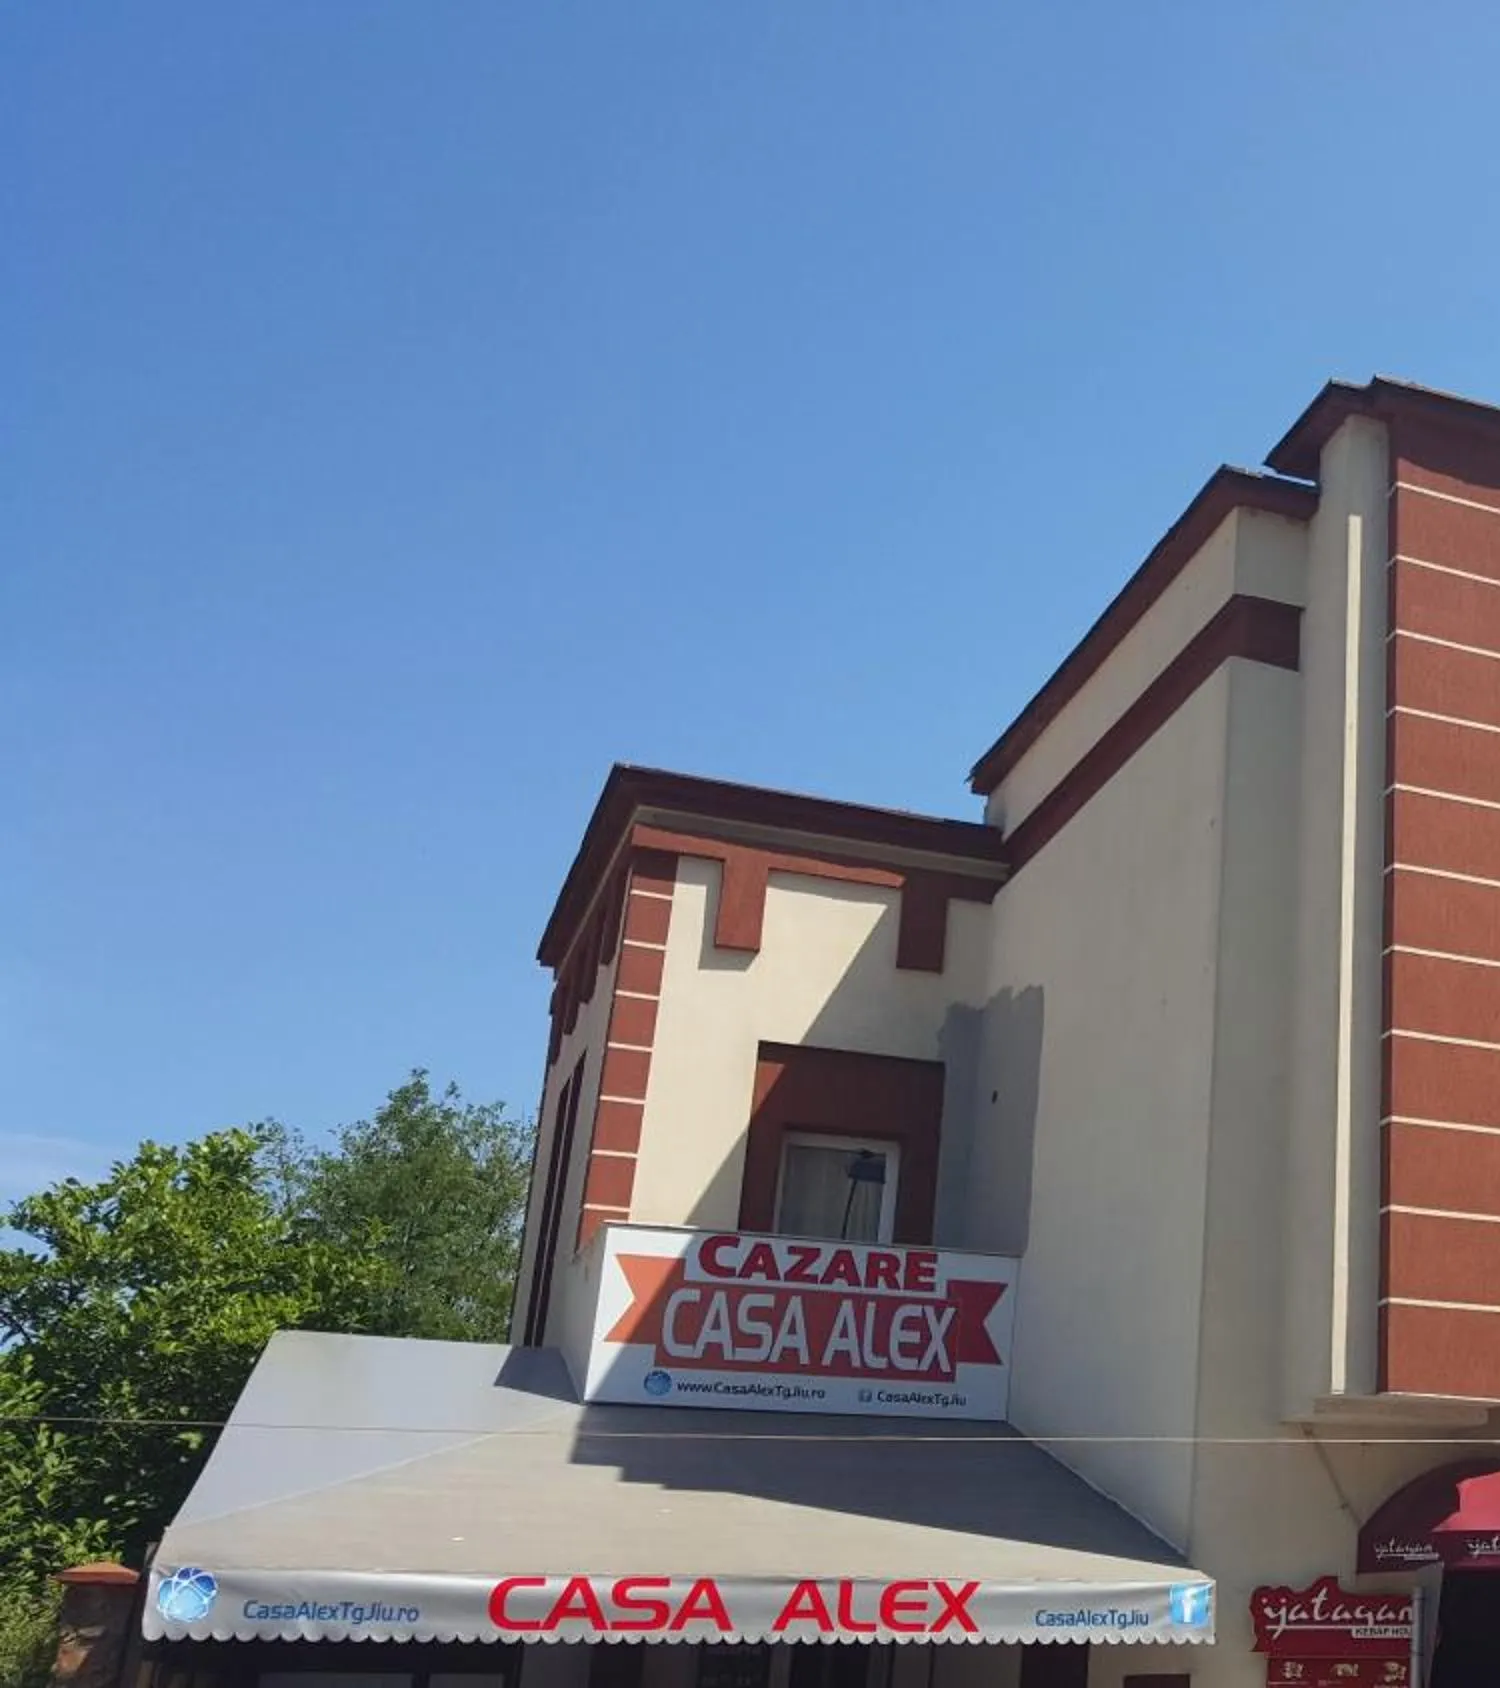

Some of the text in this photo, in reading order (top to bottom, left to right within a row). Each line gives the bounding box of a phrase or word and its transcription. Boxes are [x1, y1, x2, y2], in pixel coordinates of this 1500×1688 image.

[698, 1234, 939, 1291] CAZARE
[661, 1288, 957, 1374] CASA ALEX
[243, 1599, 420, 1625] CasaAlexTgJiu.ro
[487, 1576, 981, 1633] CASA ALEX
[1035, 1608, 1150, 1629] CasaAlexTgJiu
